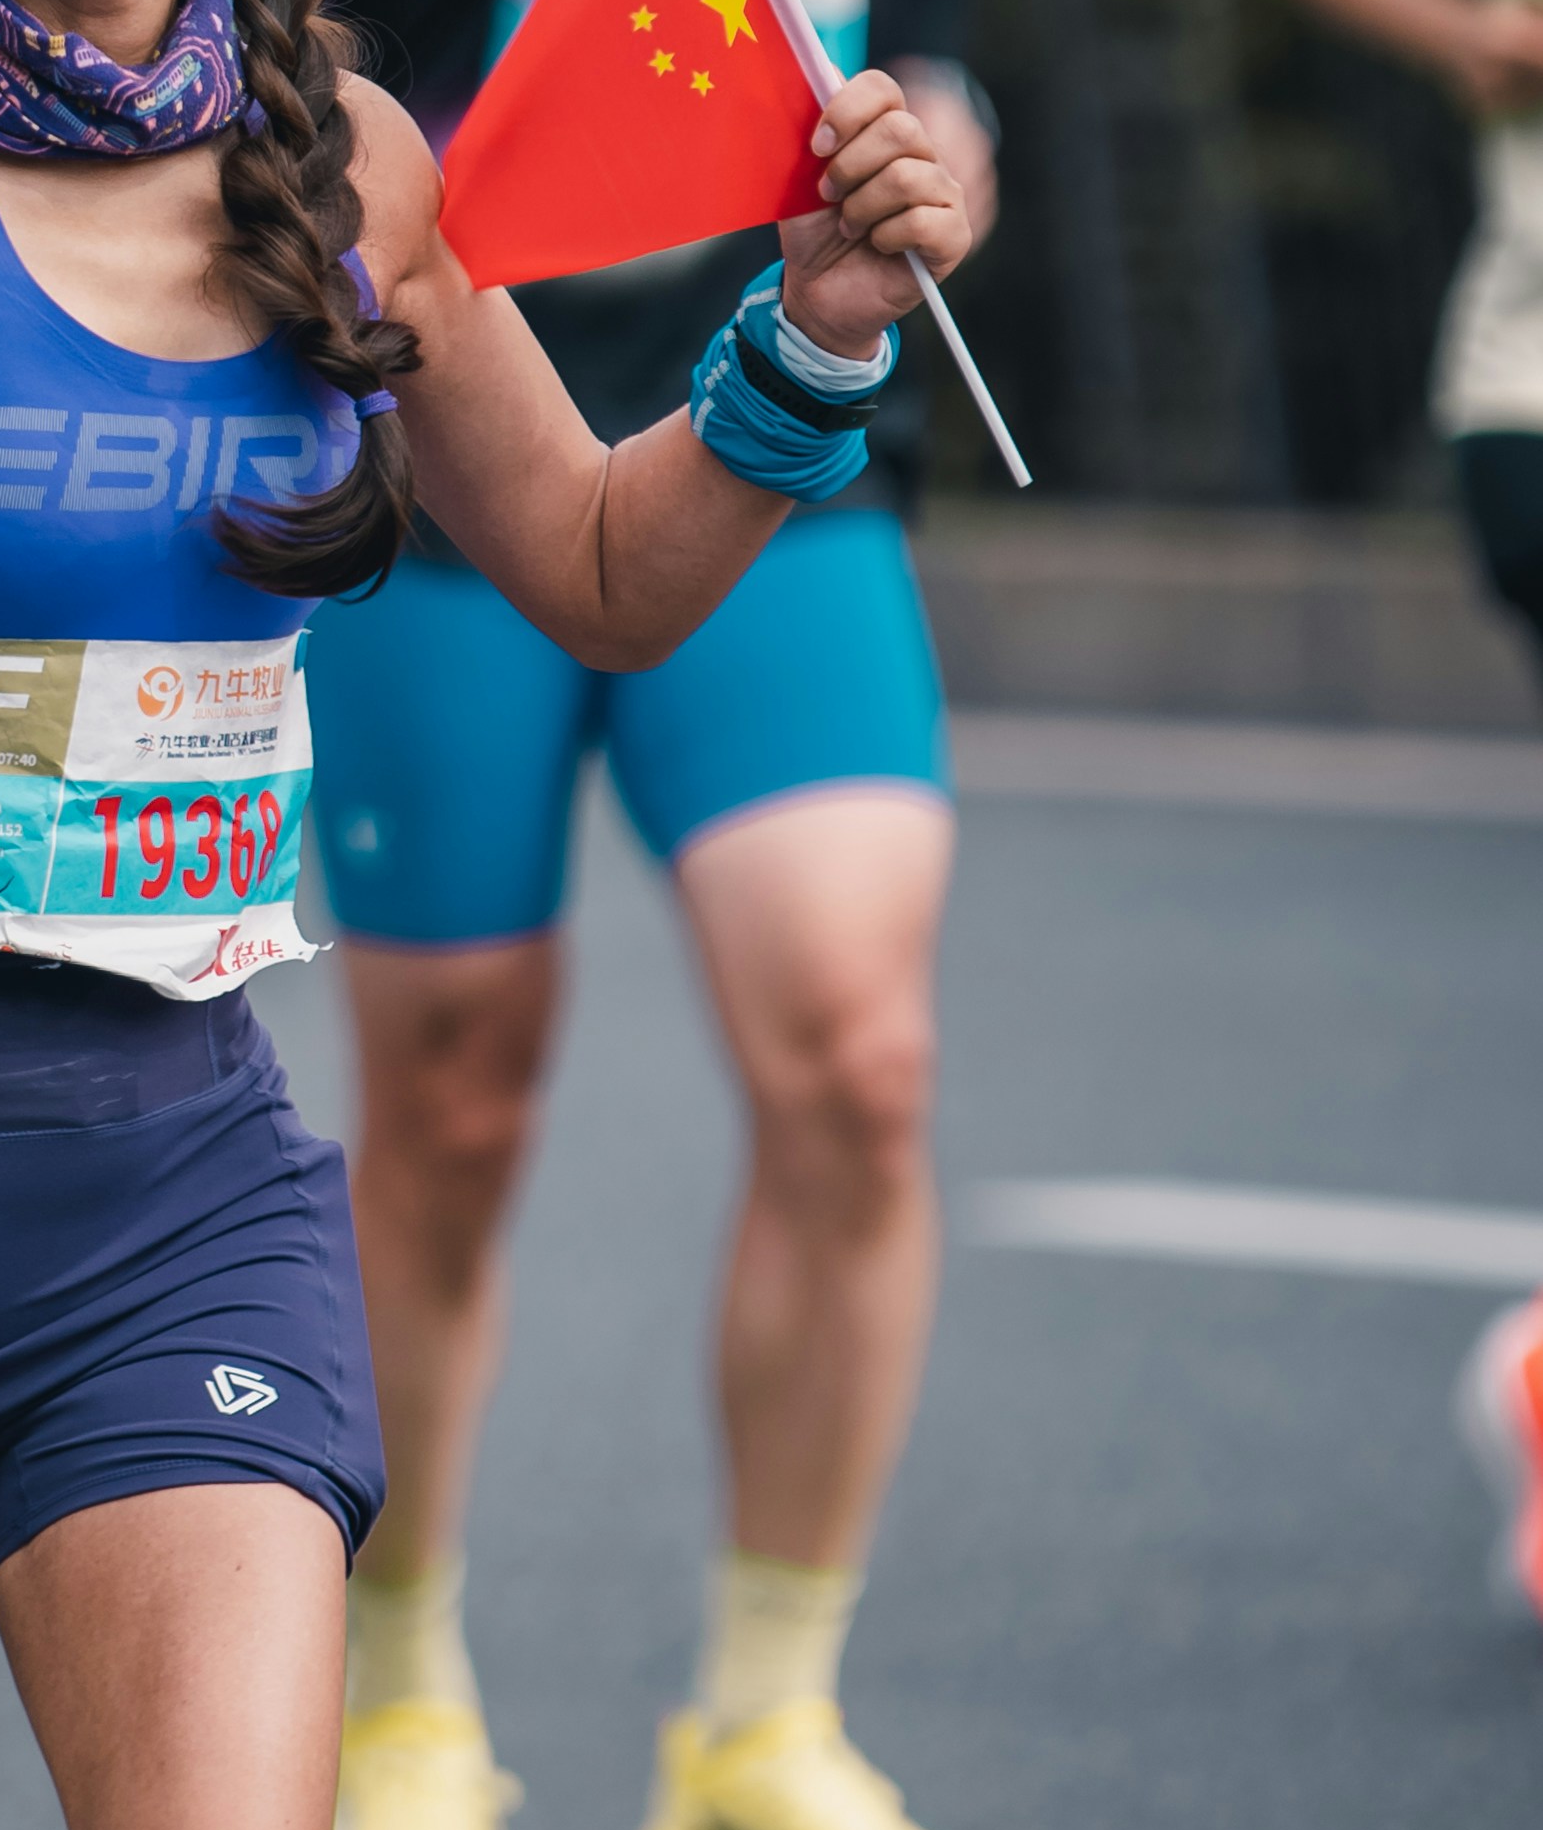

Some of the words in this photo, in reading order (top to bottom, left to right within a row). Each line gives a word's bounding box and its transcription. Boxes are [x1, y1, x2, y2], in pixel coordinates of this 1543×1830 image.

[195, 663, 287, 704] 九牛牧业
[94, 789, 283, 900] 19368
